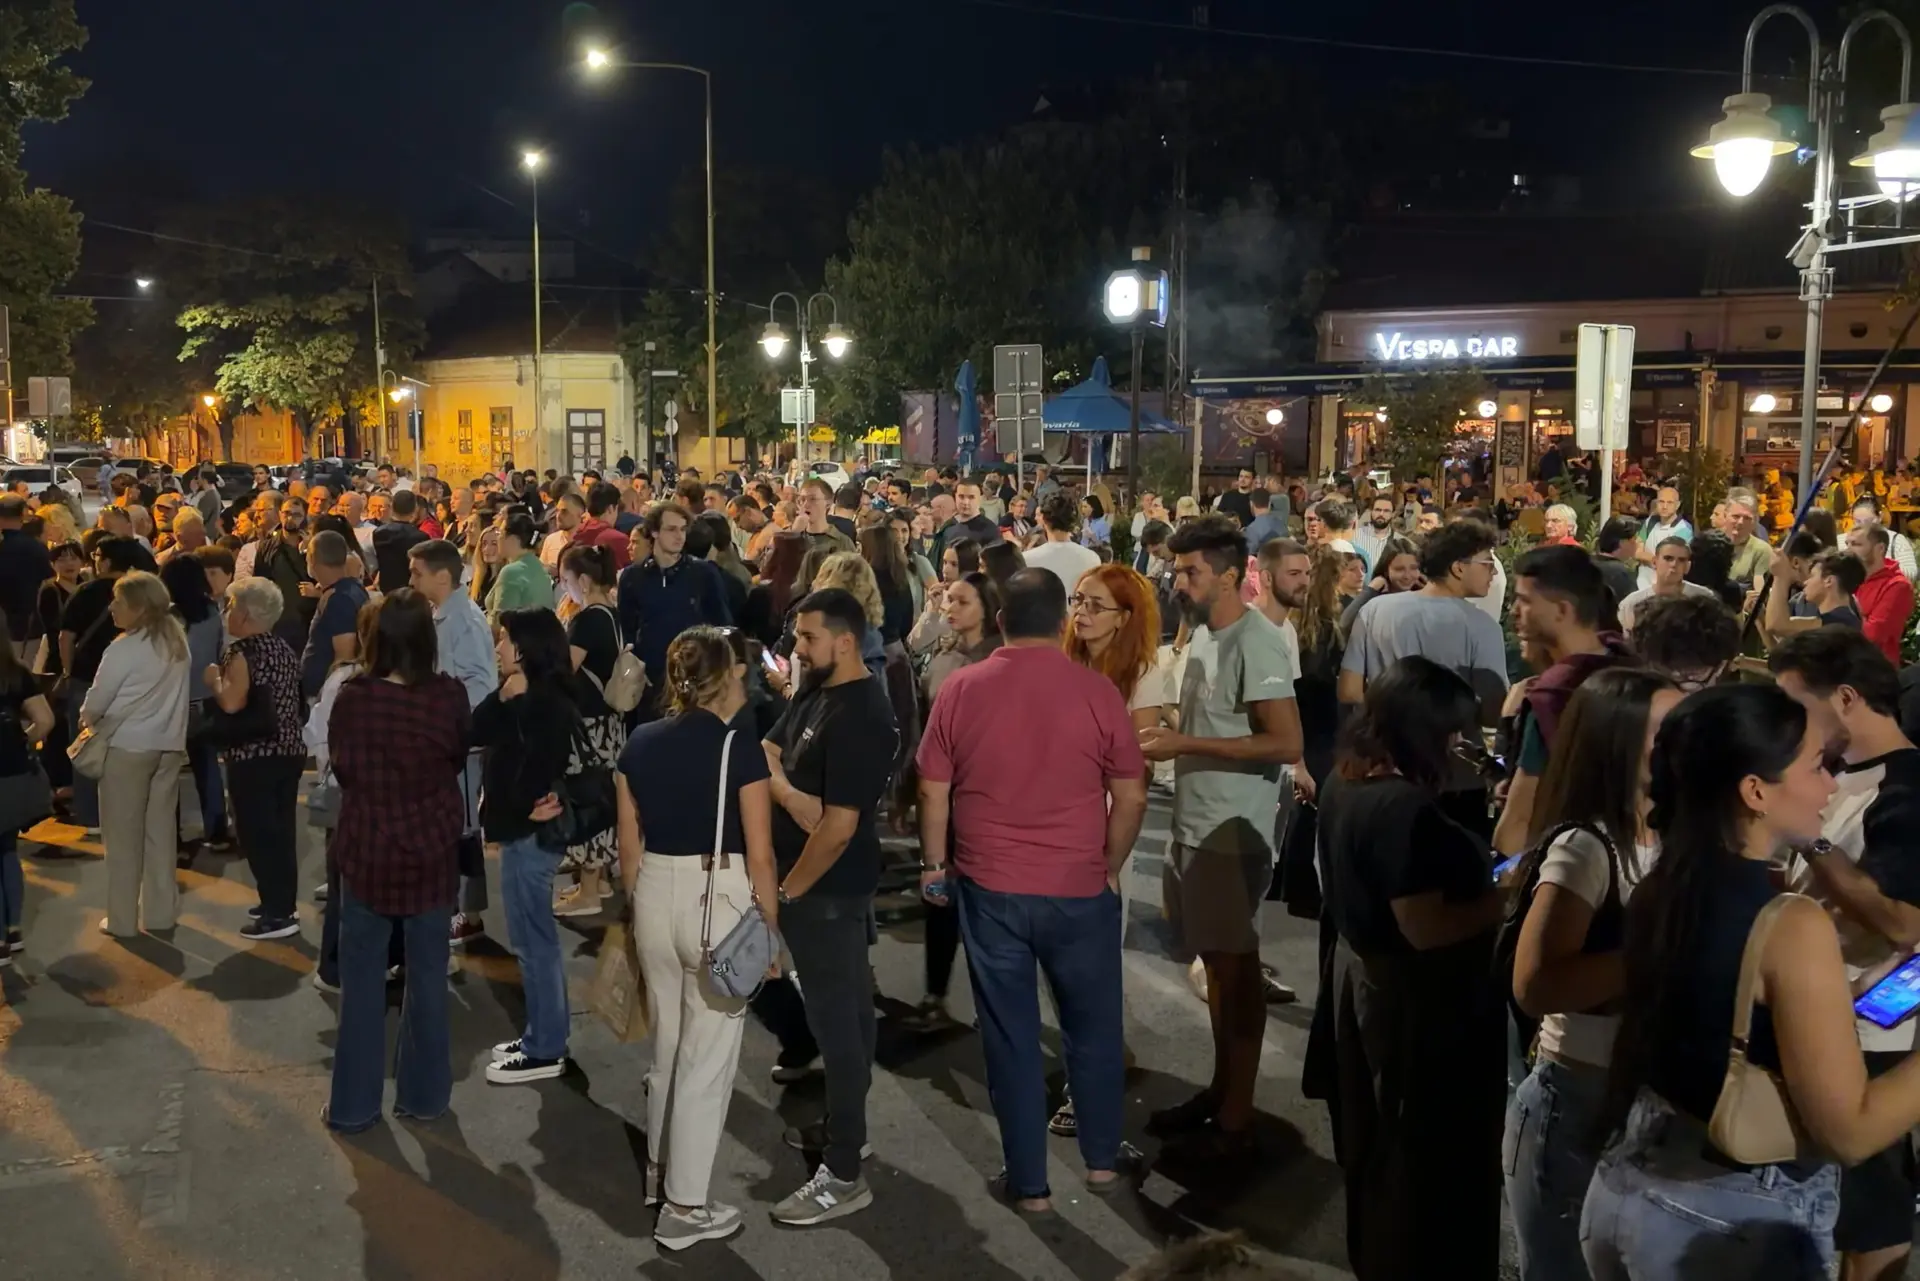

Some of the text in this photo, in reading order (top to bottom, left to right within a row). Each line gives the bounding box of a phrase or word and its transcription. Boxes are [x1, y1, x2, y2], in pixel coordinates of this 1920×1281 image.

[1375, 332, 1518, 360] VESPA BAR
[1043, 420, 1080, 429] avaria
[814, 1191, 838, 1209] N
